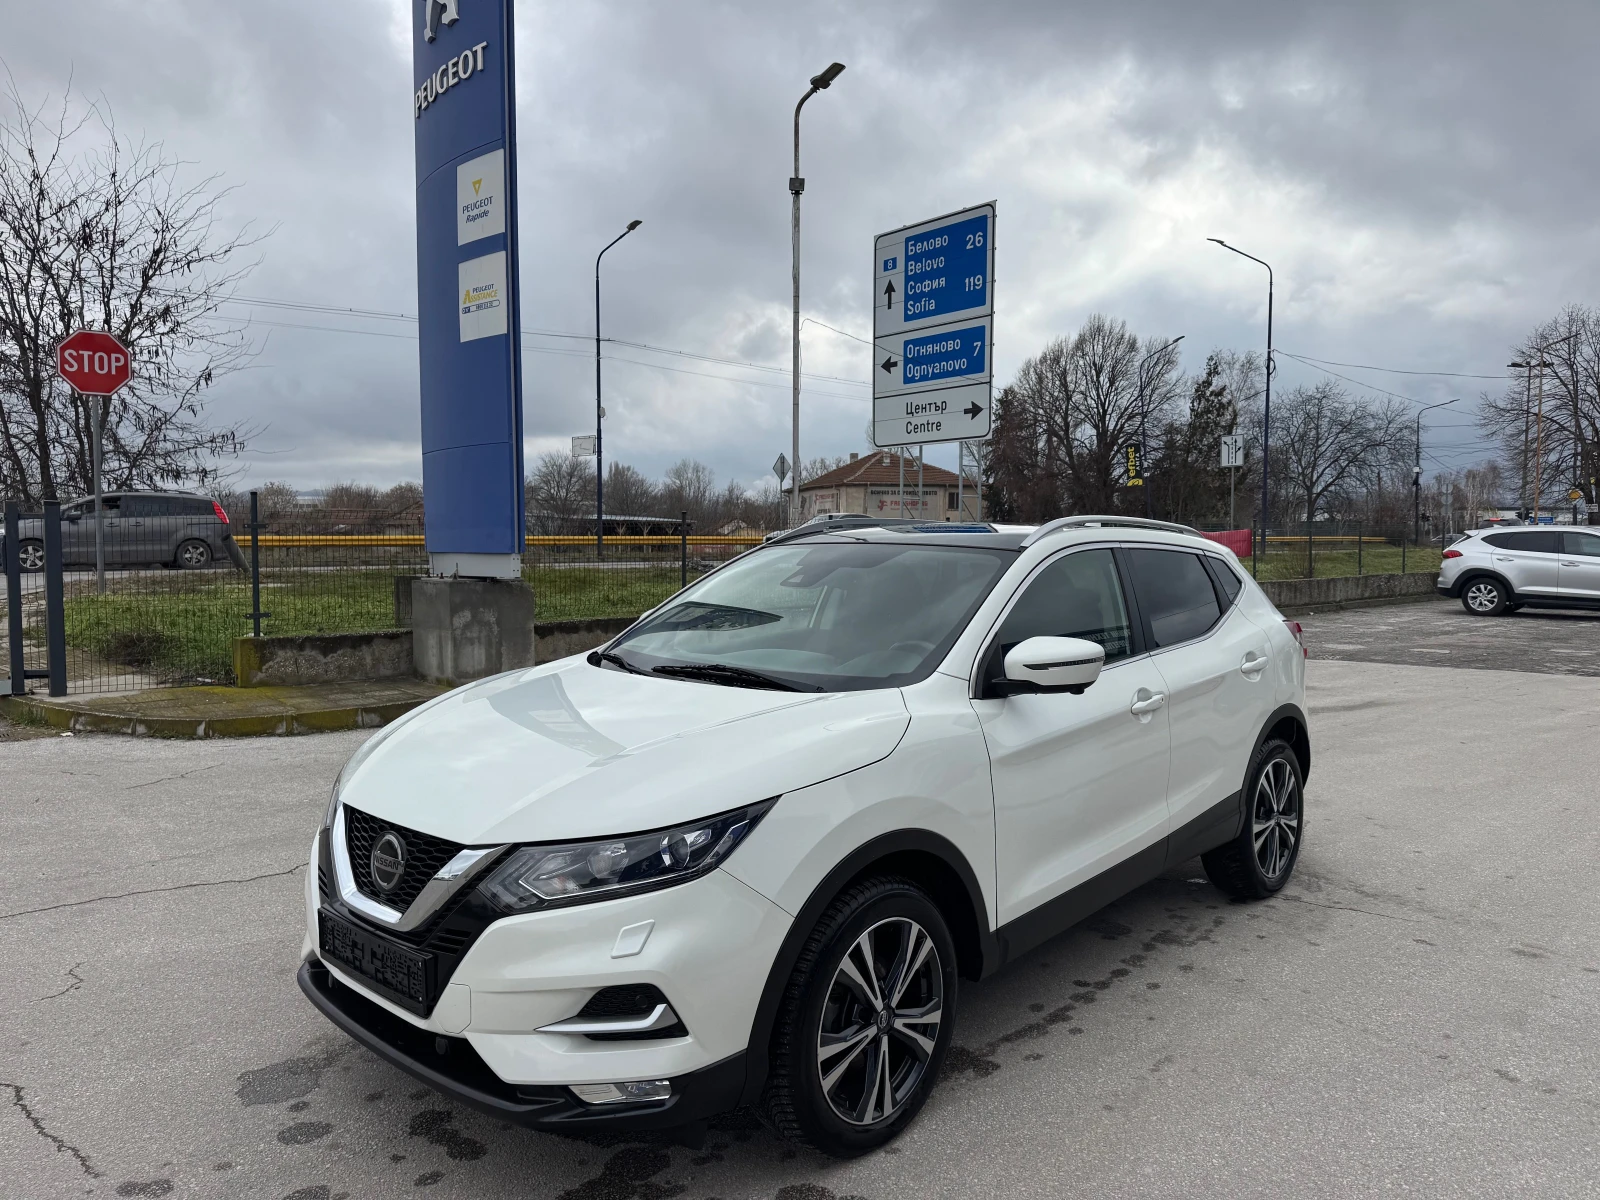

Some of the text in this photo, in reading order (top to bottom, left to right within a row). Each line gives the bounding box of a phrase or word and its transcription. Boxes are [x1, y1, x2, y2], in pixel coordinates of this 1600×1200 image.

[415, 41, 488, 118] PEUGEOT
[462, 196, 494, 215] PEUGEOT
[465, 209, 490, 224] Rapide
[908, 232, 984, 256] Белово 26
[887, 260, 893, 270] 8
[908, 256, 945, 276] Belovo
[472, 283, 495, 294] PEUGEOT
[907, 275, 983, 295] София 119
[907, 298, 936, 315] Sofia
[906, 339, 982, 358] Огняново 7
[64, 349, 125, 375] STOP
[906, 358, 967, 380] Ognyanovo
[906, 400, 947, 416] Център
[905, 420, 942, 434] Centre
[1127, 446, 1136, 477] efbet
[375, 854, 399, 871] NISSAN
